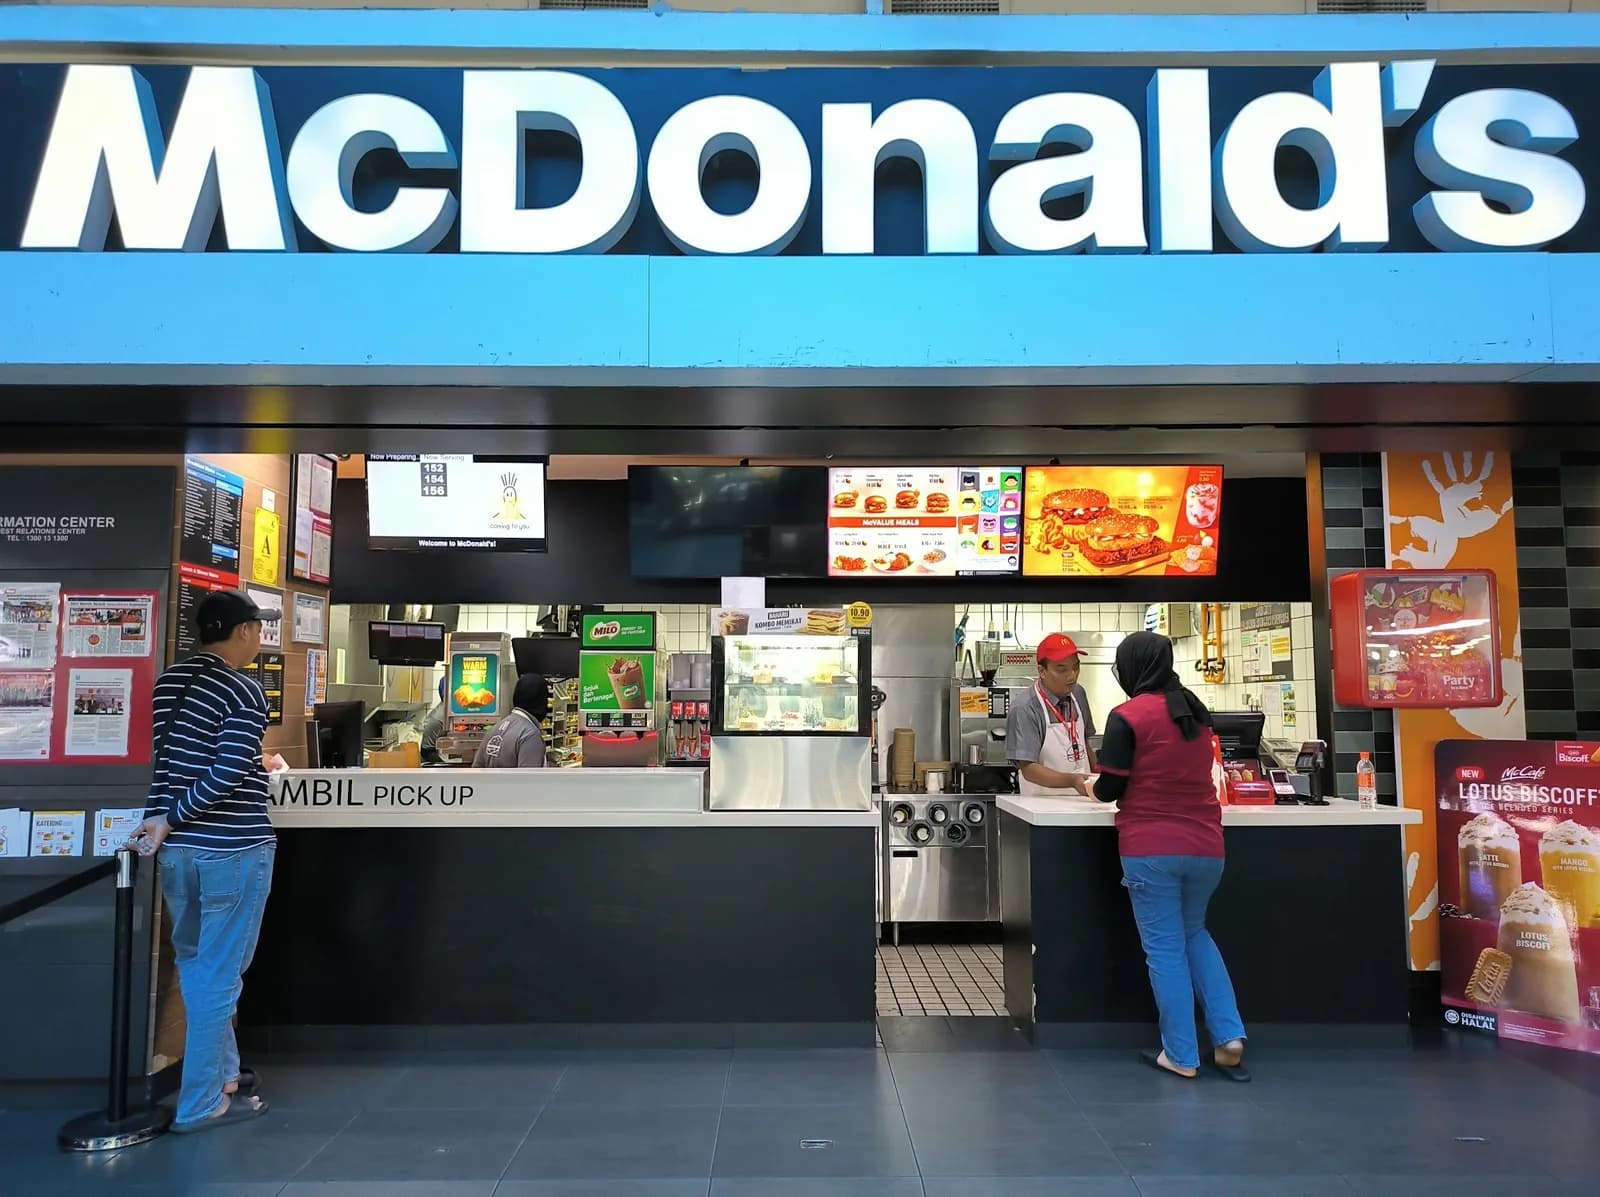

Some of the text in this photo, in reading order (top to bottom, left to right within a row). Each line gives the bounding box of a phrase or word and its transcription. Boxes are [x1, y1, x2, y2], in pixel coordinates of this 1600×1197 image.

[20, 59, 1587, 254] McDonald's
[440, 454, 465, 462] Serving
[424, 463, 444, 473] 152
[424, 474, 444, 484] 154
[423, 485, 445, 495] 156
[60, 516, 115, 528] CENTER
[261, 535, 271, 555] A
[457, 540, 497, 548] McDonald's!
[850, 608, 870, 617] 10.90
[755, 621, 776, 629] KOMBO
[593, 625, 618, 637] MILO
[463, 661, 487, 670] WARM
[1443, 675, 1475, 688] Party
[1559, 752, 1590, 763] Biscoff
[1461, 769, 1480, 779] NEW
[374, 785, 433, 806] PICK
[440, 785, 474, 806] UP
[1458, 782, 1598, 806] LOTUS BISCOFF
[1498, 802, 1538, 813] BLENDED
[1541, 805, 1574, 816] SERIES
[1560, 857, 1588, 867] MANGO
[1520, 931, 1548, 942] LOTUS
[1461, 1017, 1496, 1031] HALAL
